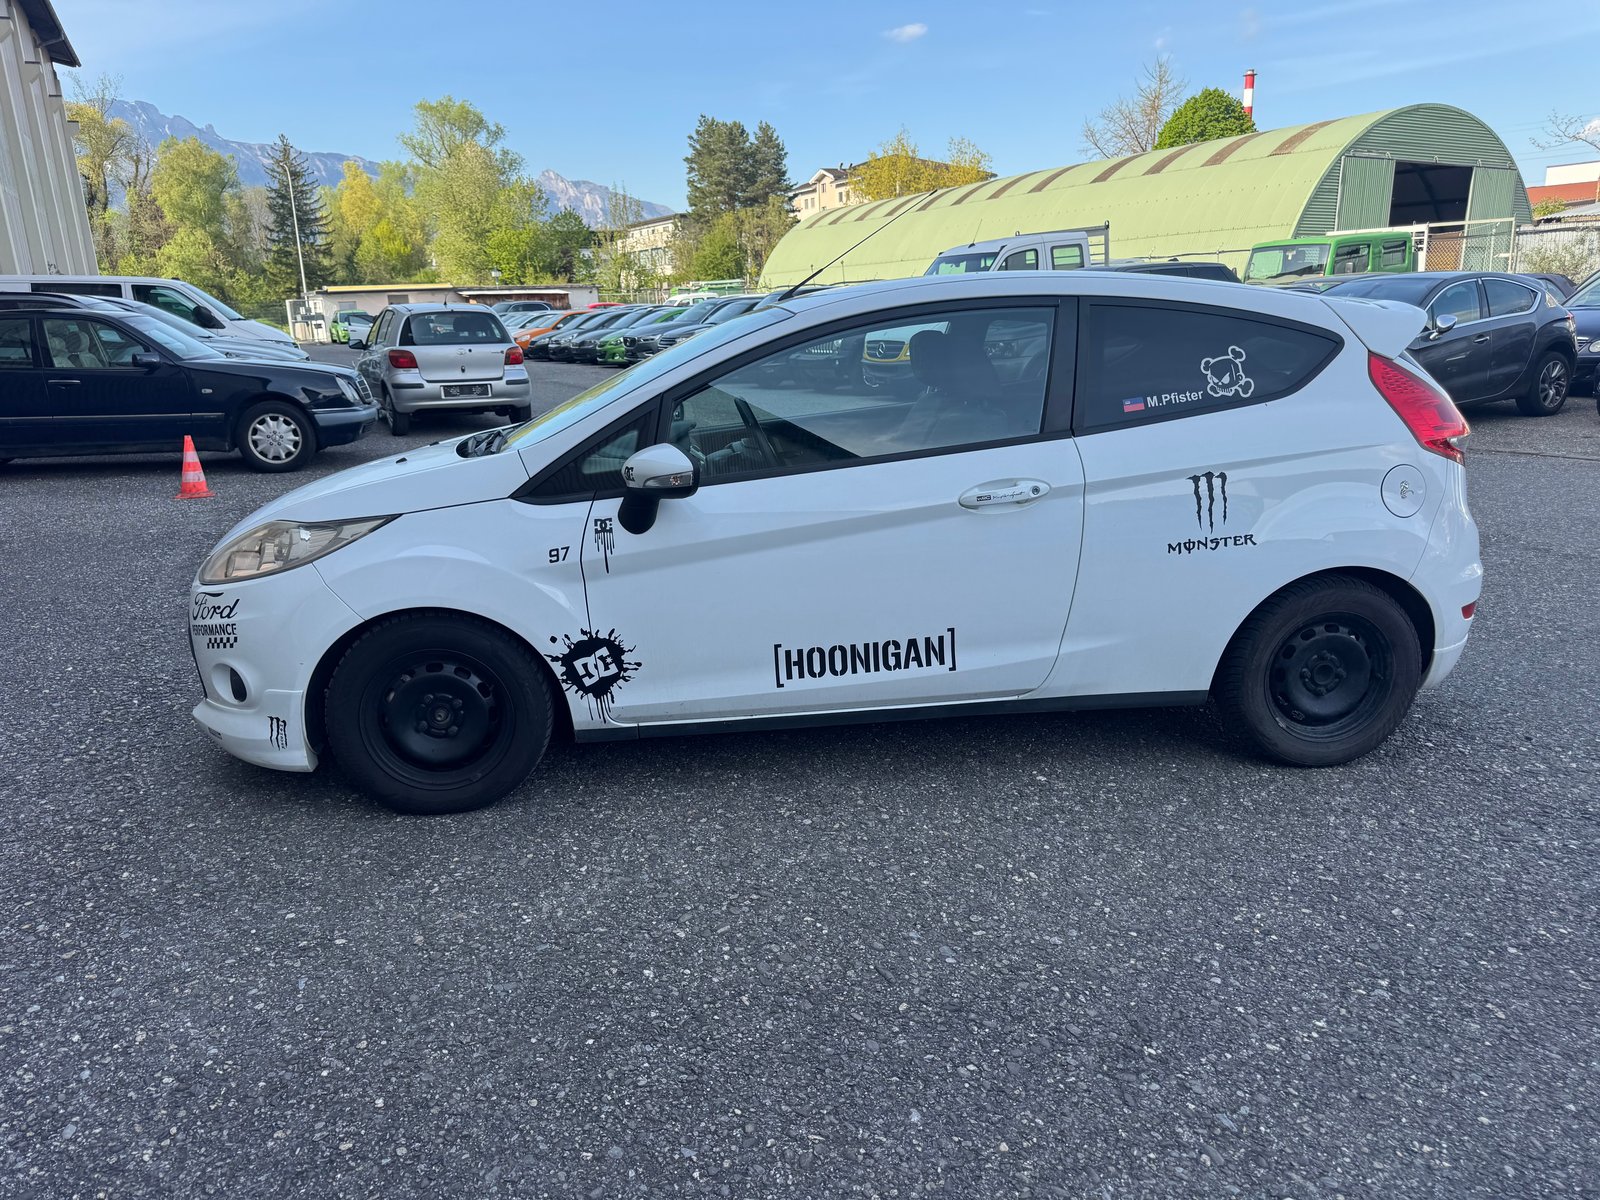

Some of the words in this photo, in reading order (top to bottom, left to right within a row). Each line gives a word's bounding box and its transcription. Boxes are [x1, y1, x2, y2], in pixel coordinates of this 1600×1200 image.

[1146, 390, 1203, 408] M.Pfister
[549, 546, 570, 563] 97
[192, 592, 240, 621] Ford
